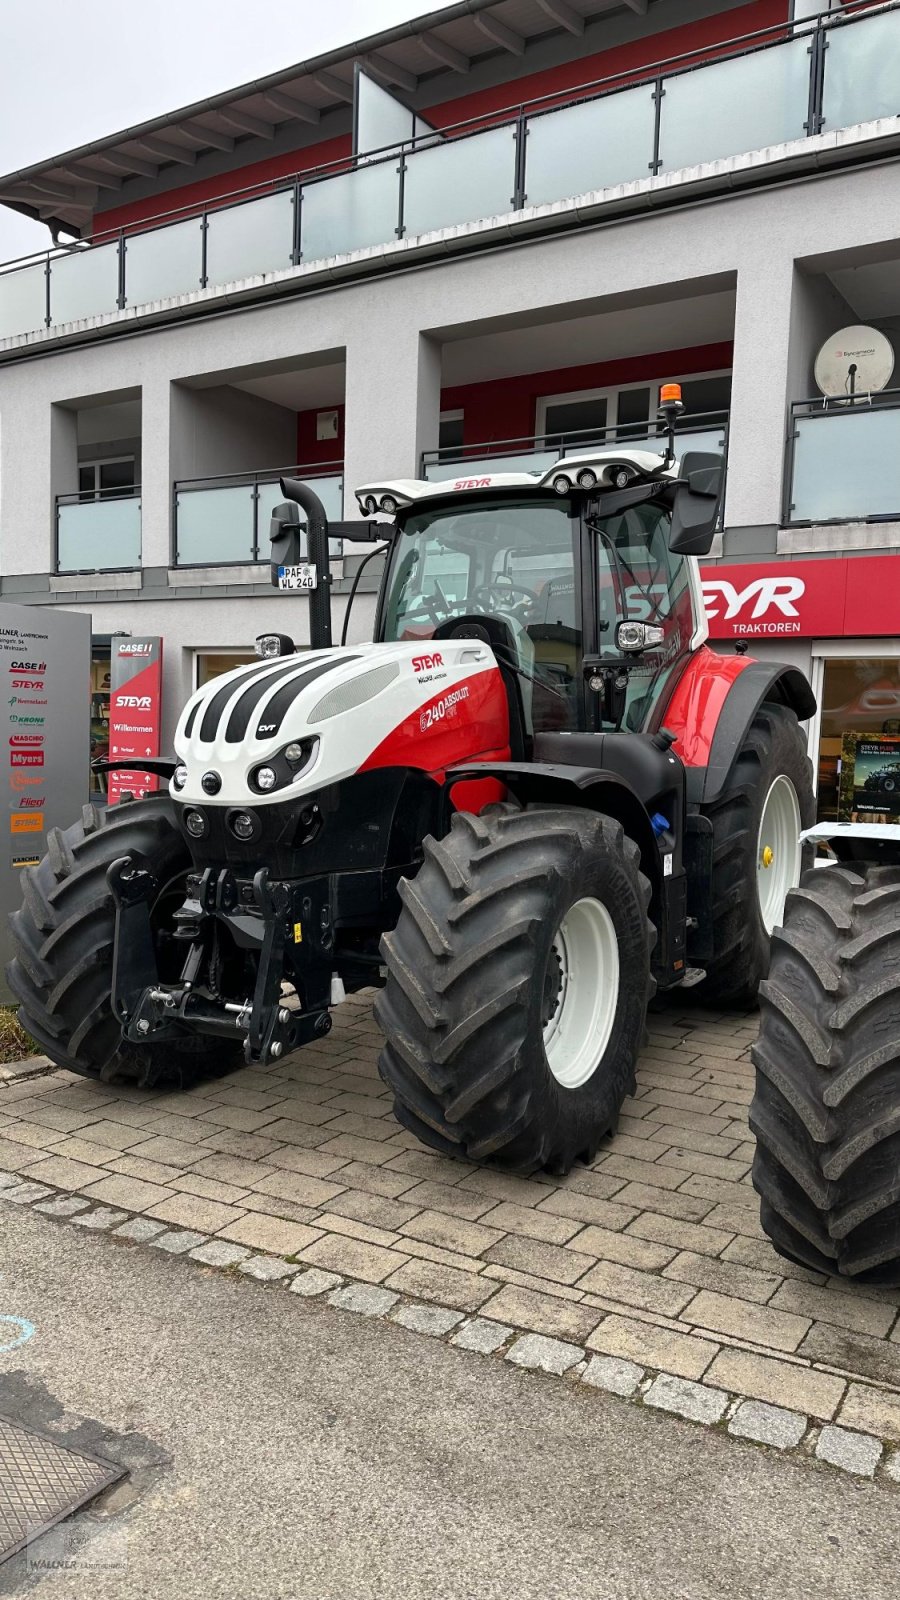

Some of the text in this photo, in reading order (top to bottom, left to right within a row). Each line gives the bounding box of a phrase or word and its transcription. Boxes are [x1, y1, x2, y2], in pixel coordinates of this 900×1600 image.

[453, 477, 492, 490] STEYR
[285, 567, 302, 578] PAF
[282, 578, 313, 589] WL 240
[732, 622, 802, 634] TRAKTOREN
[119, 643, 144, 653] CASE
[11, 661, 37, 670] CASE
[412, 652, 445, 672] STEYR
[11, 680, 44, 689] STEYR
[115, 695, 152, 708] STEYR
[444, 686, 470, 709] ABSOLUT
[113, 723, 154, 733] Willkommen
[258, 724, 277, 732] CVT
[12, 753, 43, 765] Myers
[19, 796, 46, 808] Fliegl
